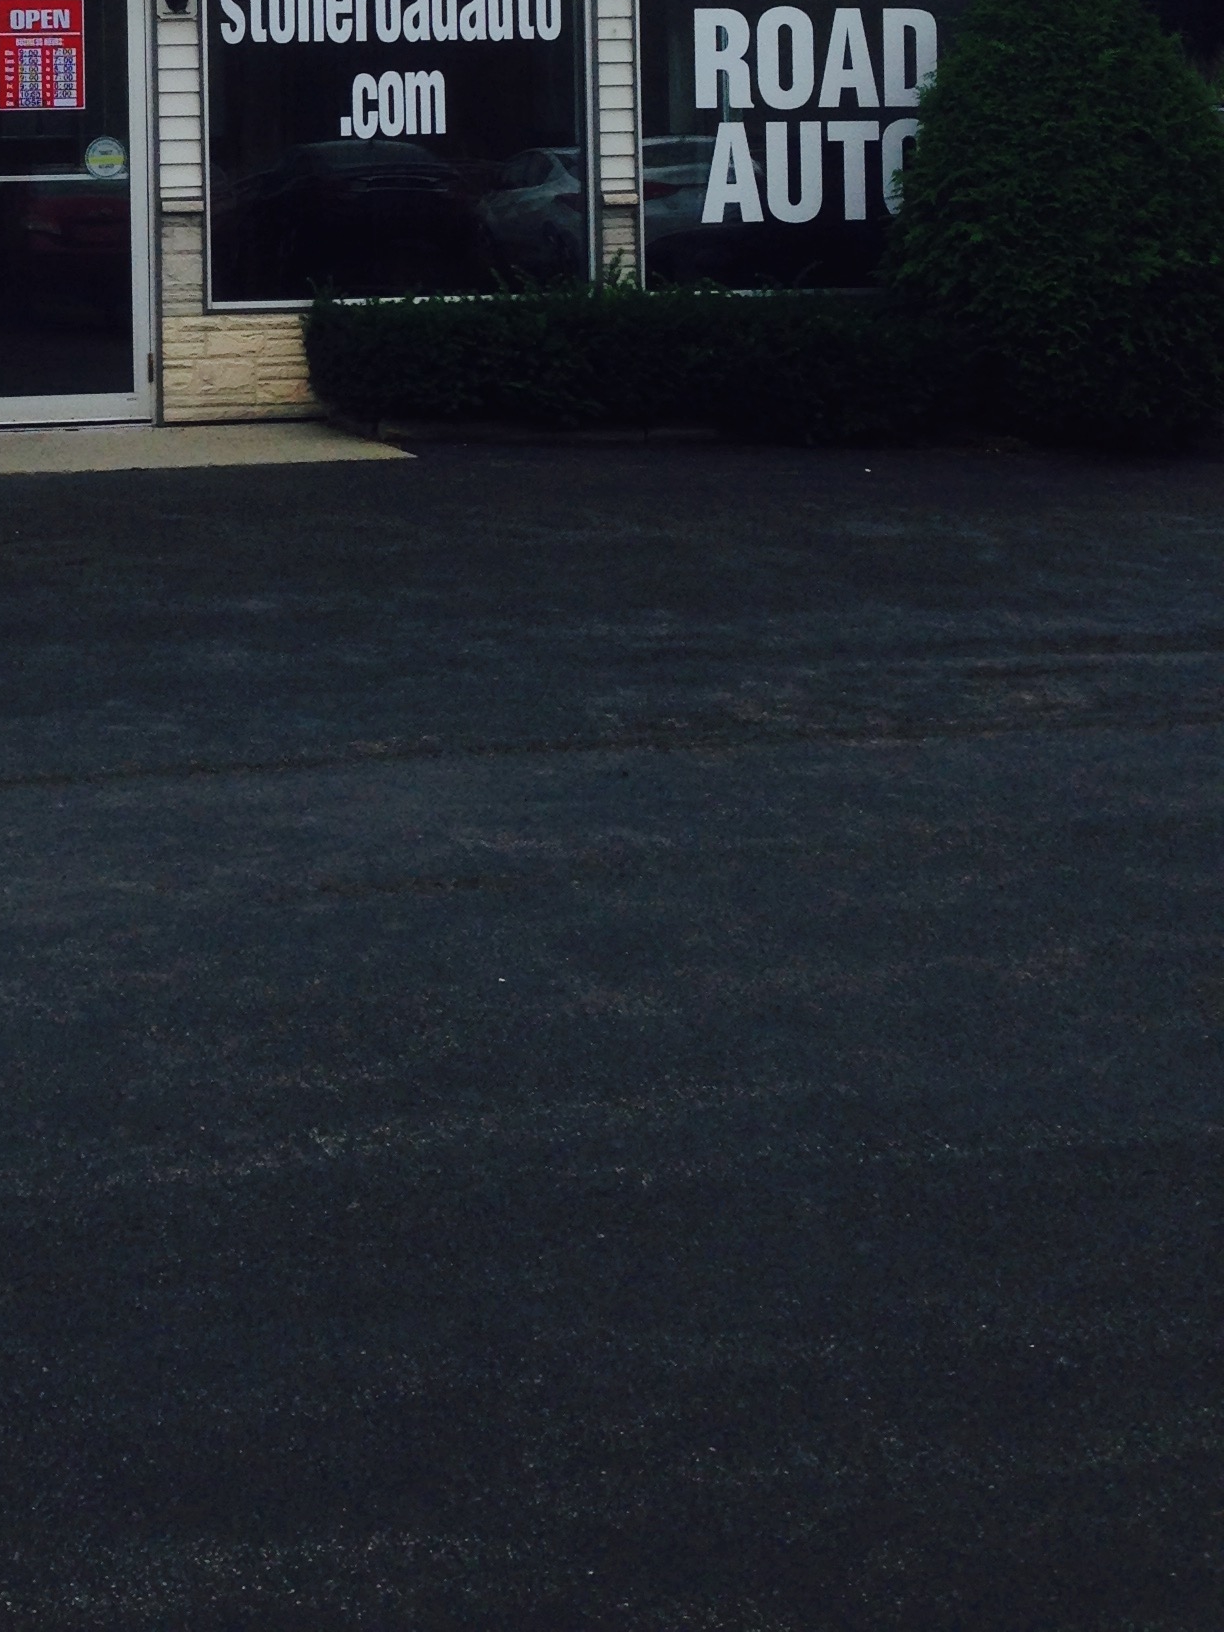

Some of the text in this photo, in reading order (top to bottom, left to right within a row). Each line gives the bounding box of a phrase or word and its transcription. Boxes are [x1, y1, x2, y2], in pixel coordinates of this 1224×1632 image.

[9, 9, 71, 30] OPEN
[694, 6, 938, 110] ROAD
[340, 69, 447, 140] .com
